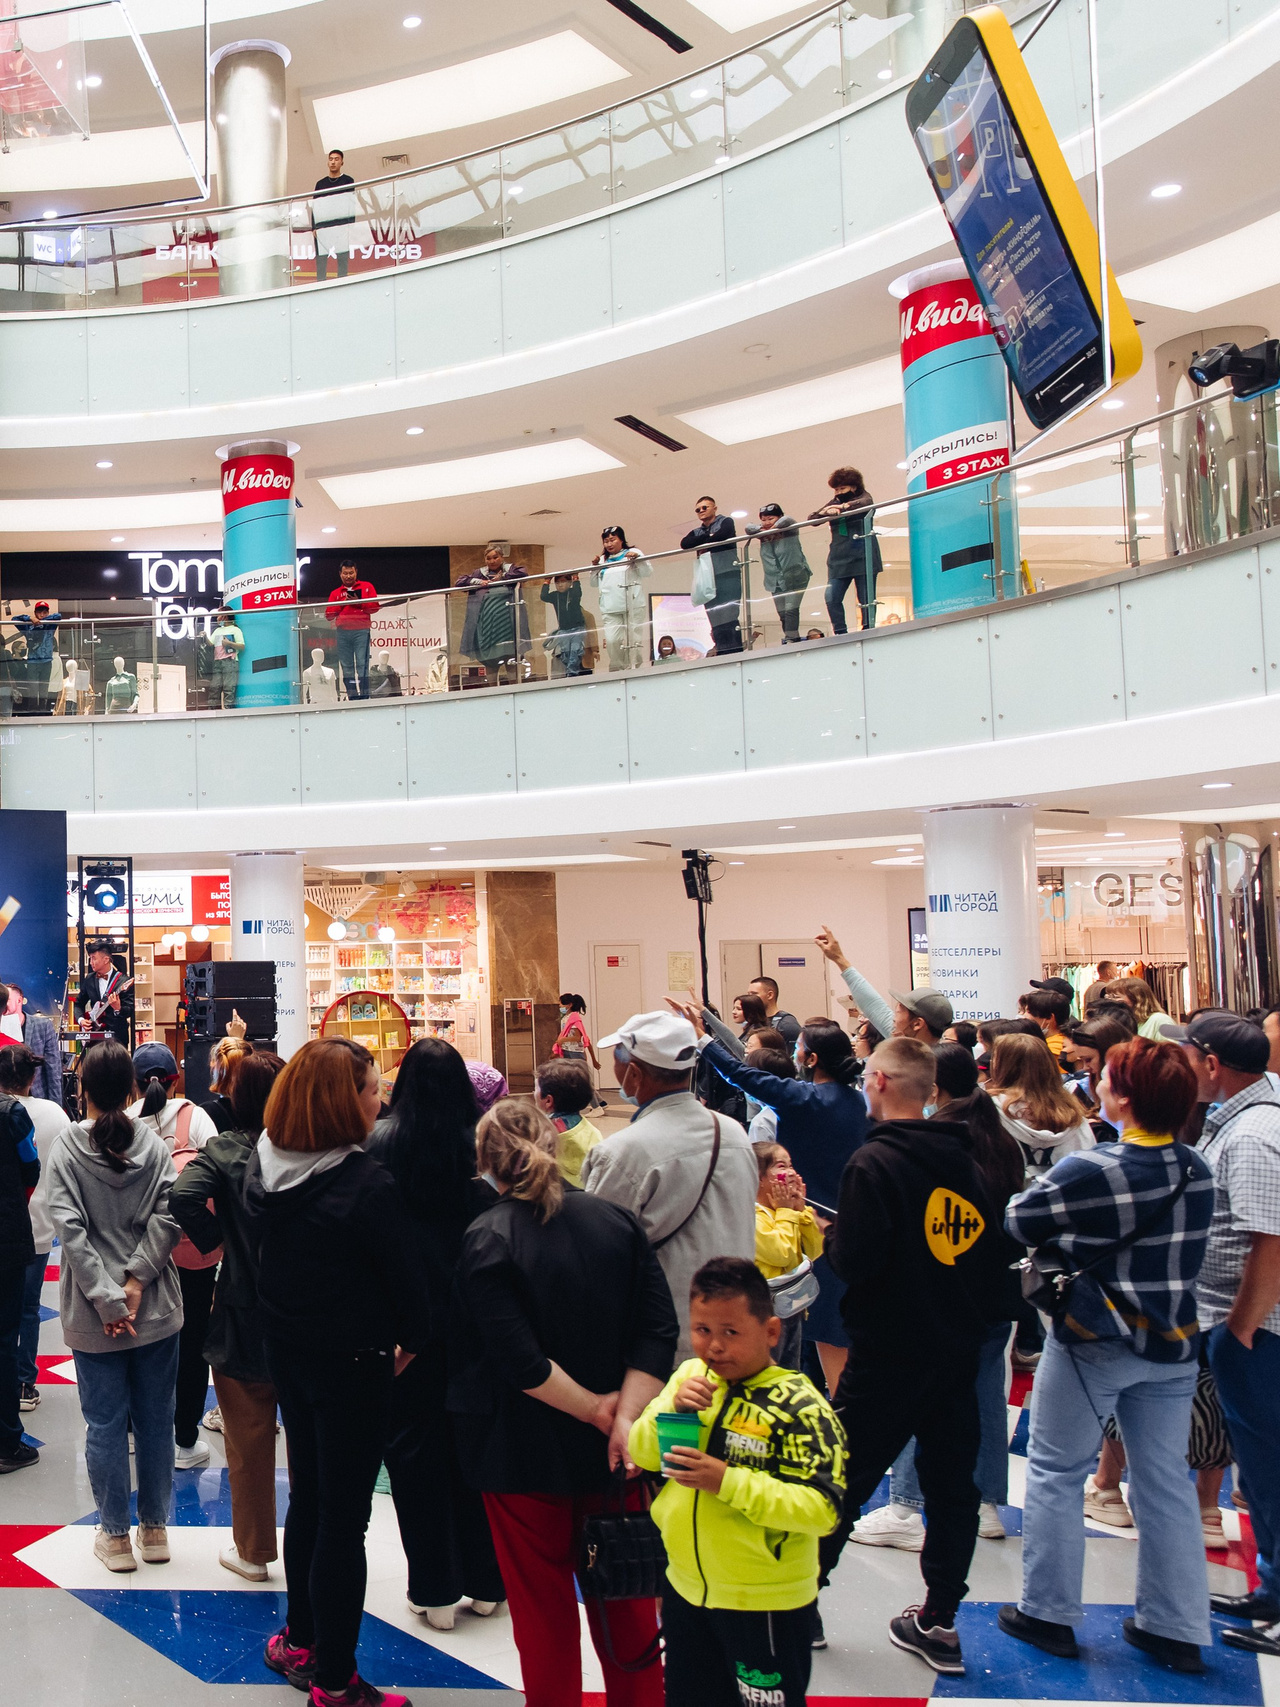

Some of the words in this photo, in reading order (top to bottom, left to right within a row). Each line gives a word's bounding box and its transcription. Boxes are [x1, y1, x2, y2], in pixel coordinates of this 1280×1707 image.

[155, 244, 219, 261] БАНК
[912, 430, 998, 469] ОТКРЫЛИСЬ!
[956, 453, 1006, 476] ЭТАЖ
[230, 571, 291, 593] ОТКРЫЛИСЬ!
[263, 590, 294, 602] ЭТАЖ
[370, 620, 414, 631] ОДАЖА
[954, 890, 997, 902] ЧИТАЙ
[954, 902, 999, 913] ГОРОД
[266, 919, 295, 927] ЧИТАЙ
[266, 926, 296, 935] ГОРОД
[952, 1010, 1001, 1021] ЕЛЯРИЯ
